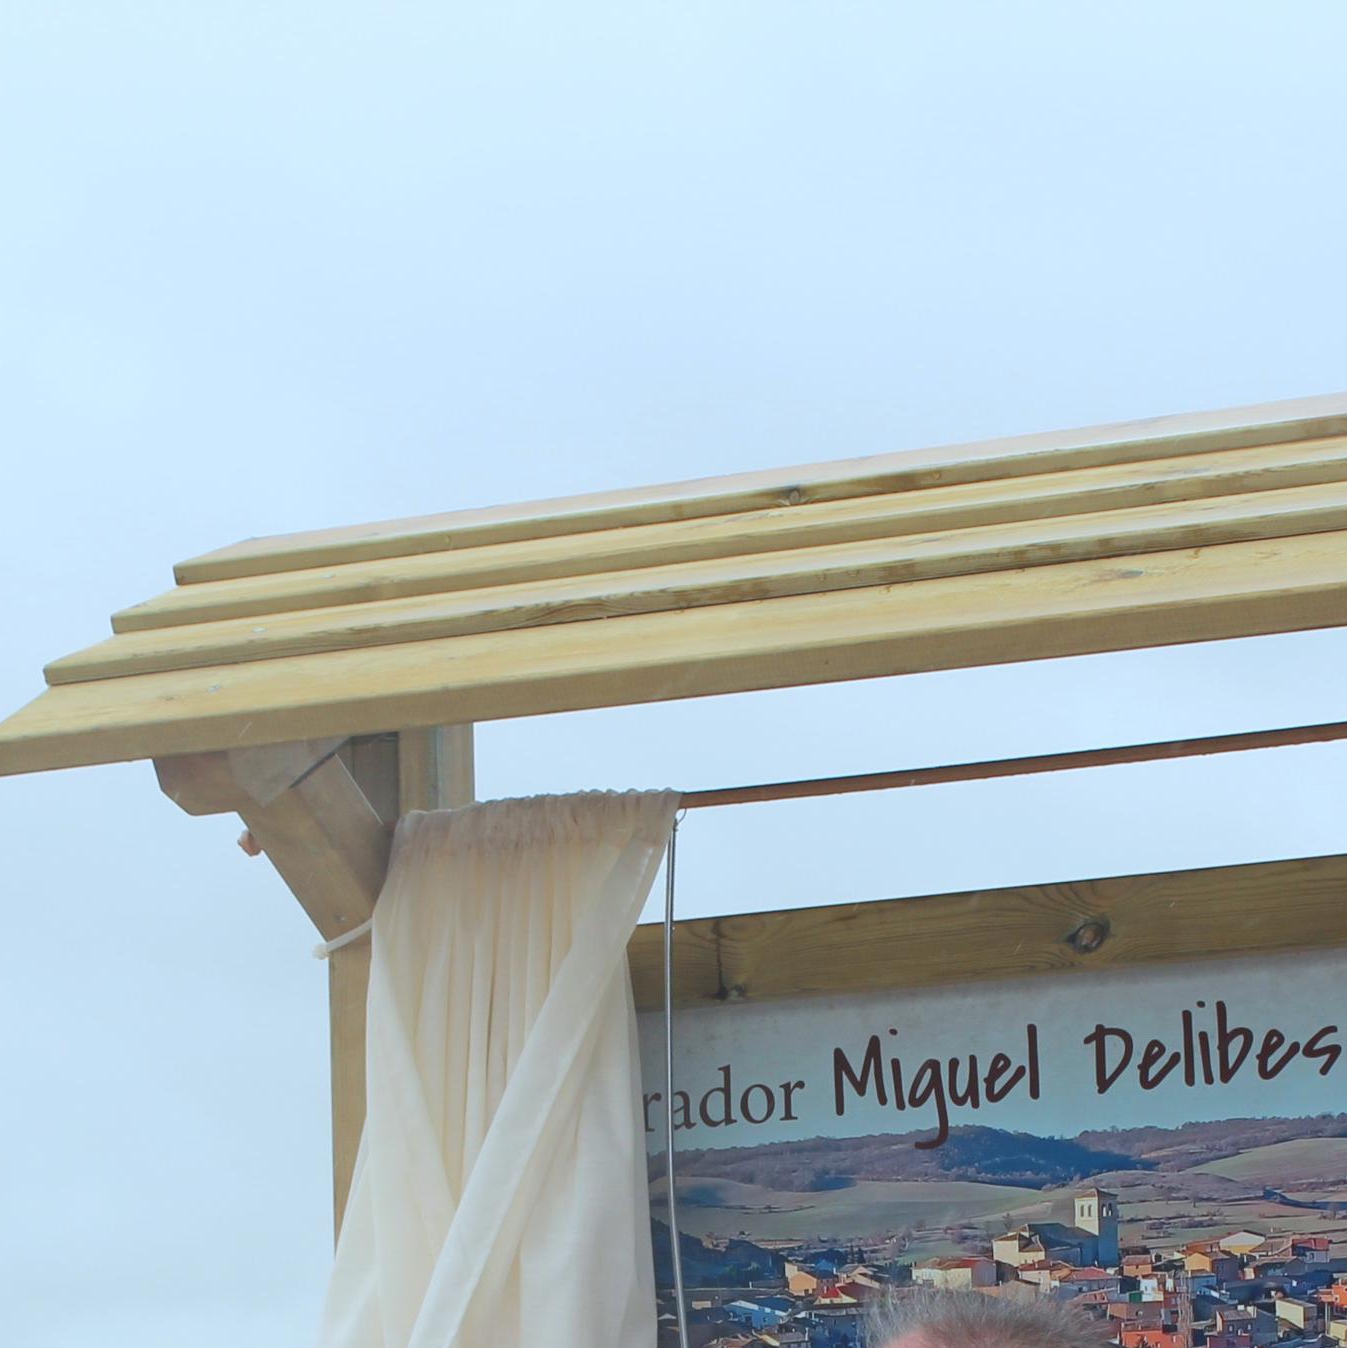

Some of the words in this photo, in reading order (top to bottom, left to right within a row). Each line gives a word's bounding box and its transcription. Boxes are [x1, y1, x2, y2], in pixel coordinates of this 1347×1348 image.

[643, 1064, 806, 1133] rador
[833, 1023, 1040, 1150] Miguel
[1083, 1000, 1343, 1095] Delibes
